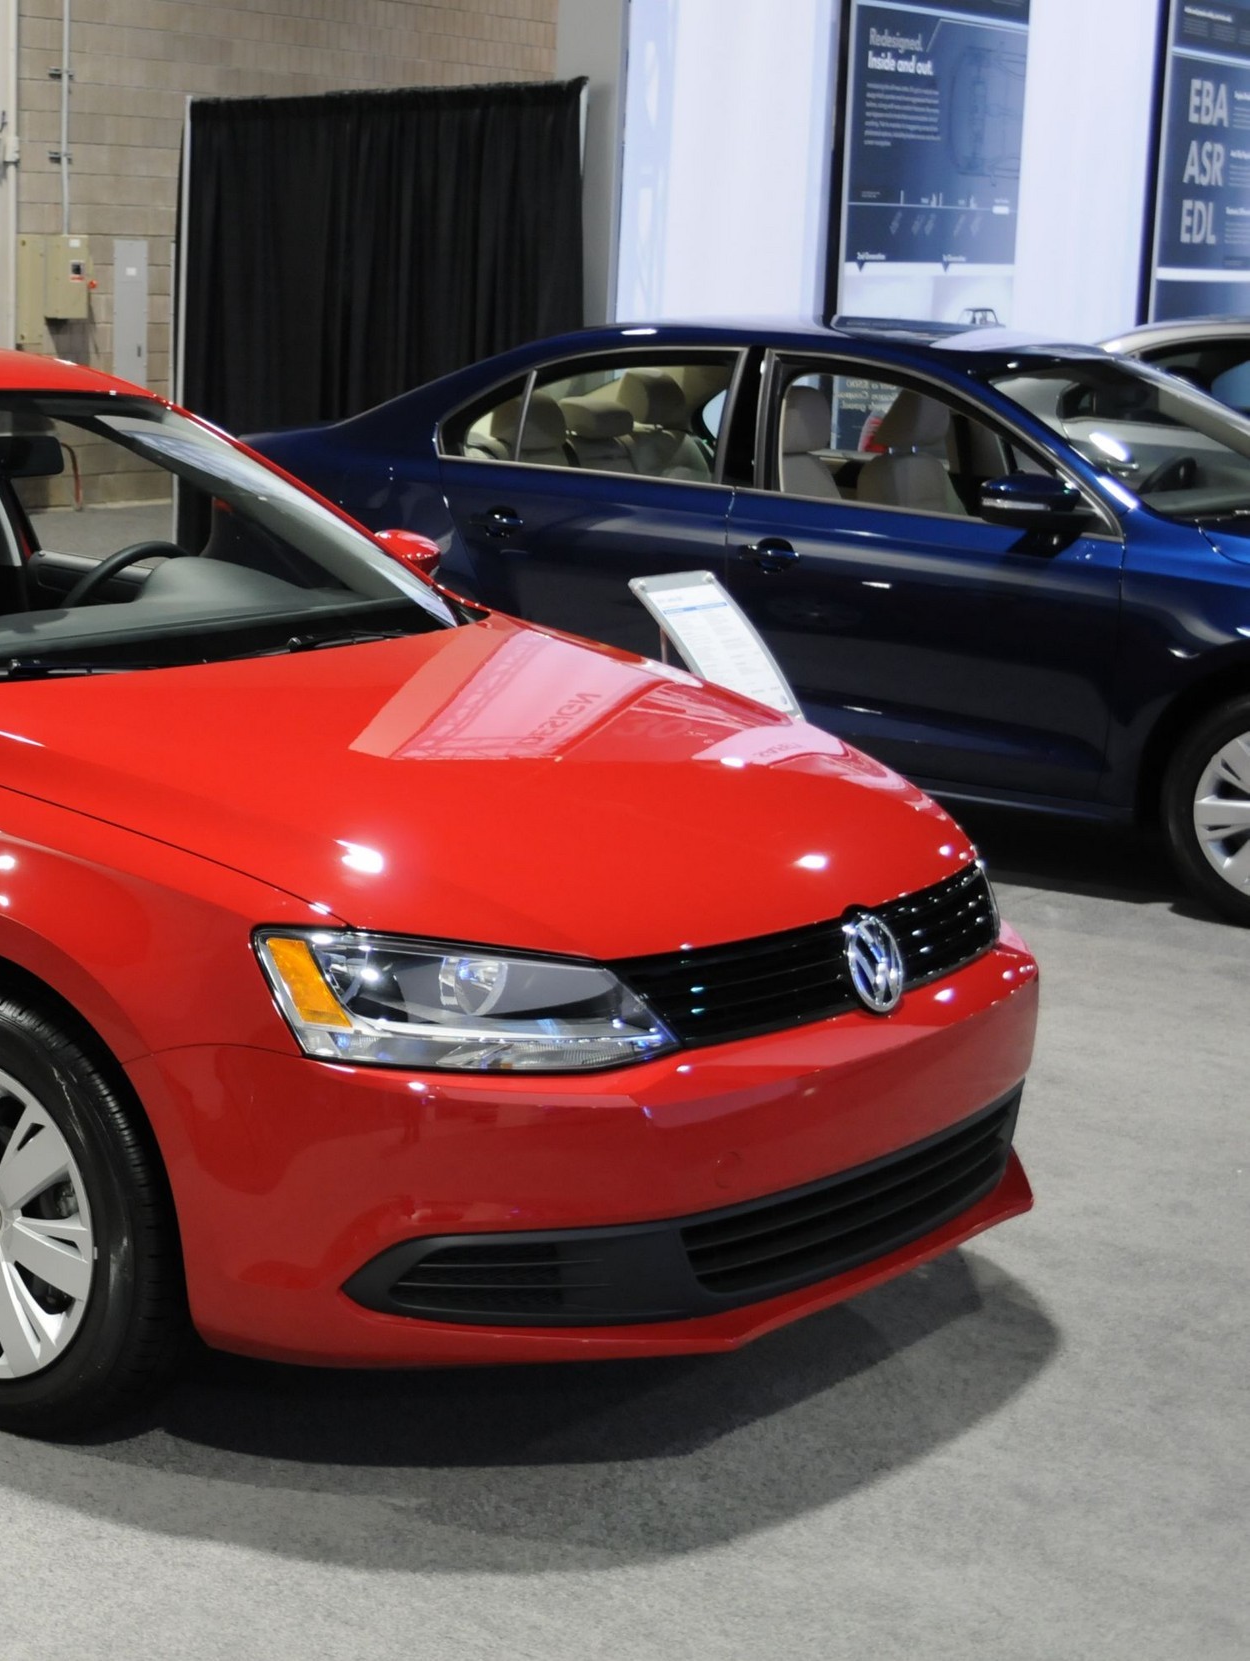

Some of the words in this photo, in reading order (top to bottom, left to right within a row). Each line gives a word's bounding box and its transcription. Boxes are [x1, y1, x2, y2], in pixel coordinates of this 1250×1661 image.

[868, 50, 896, 71] Inside
[896, 54, 915, 73] and
[1188, 78, 1229, 128] EBA
[1182, 140, 1224, 186] ASR
[1180, 199, 1216, 244] EDL
